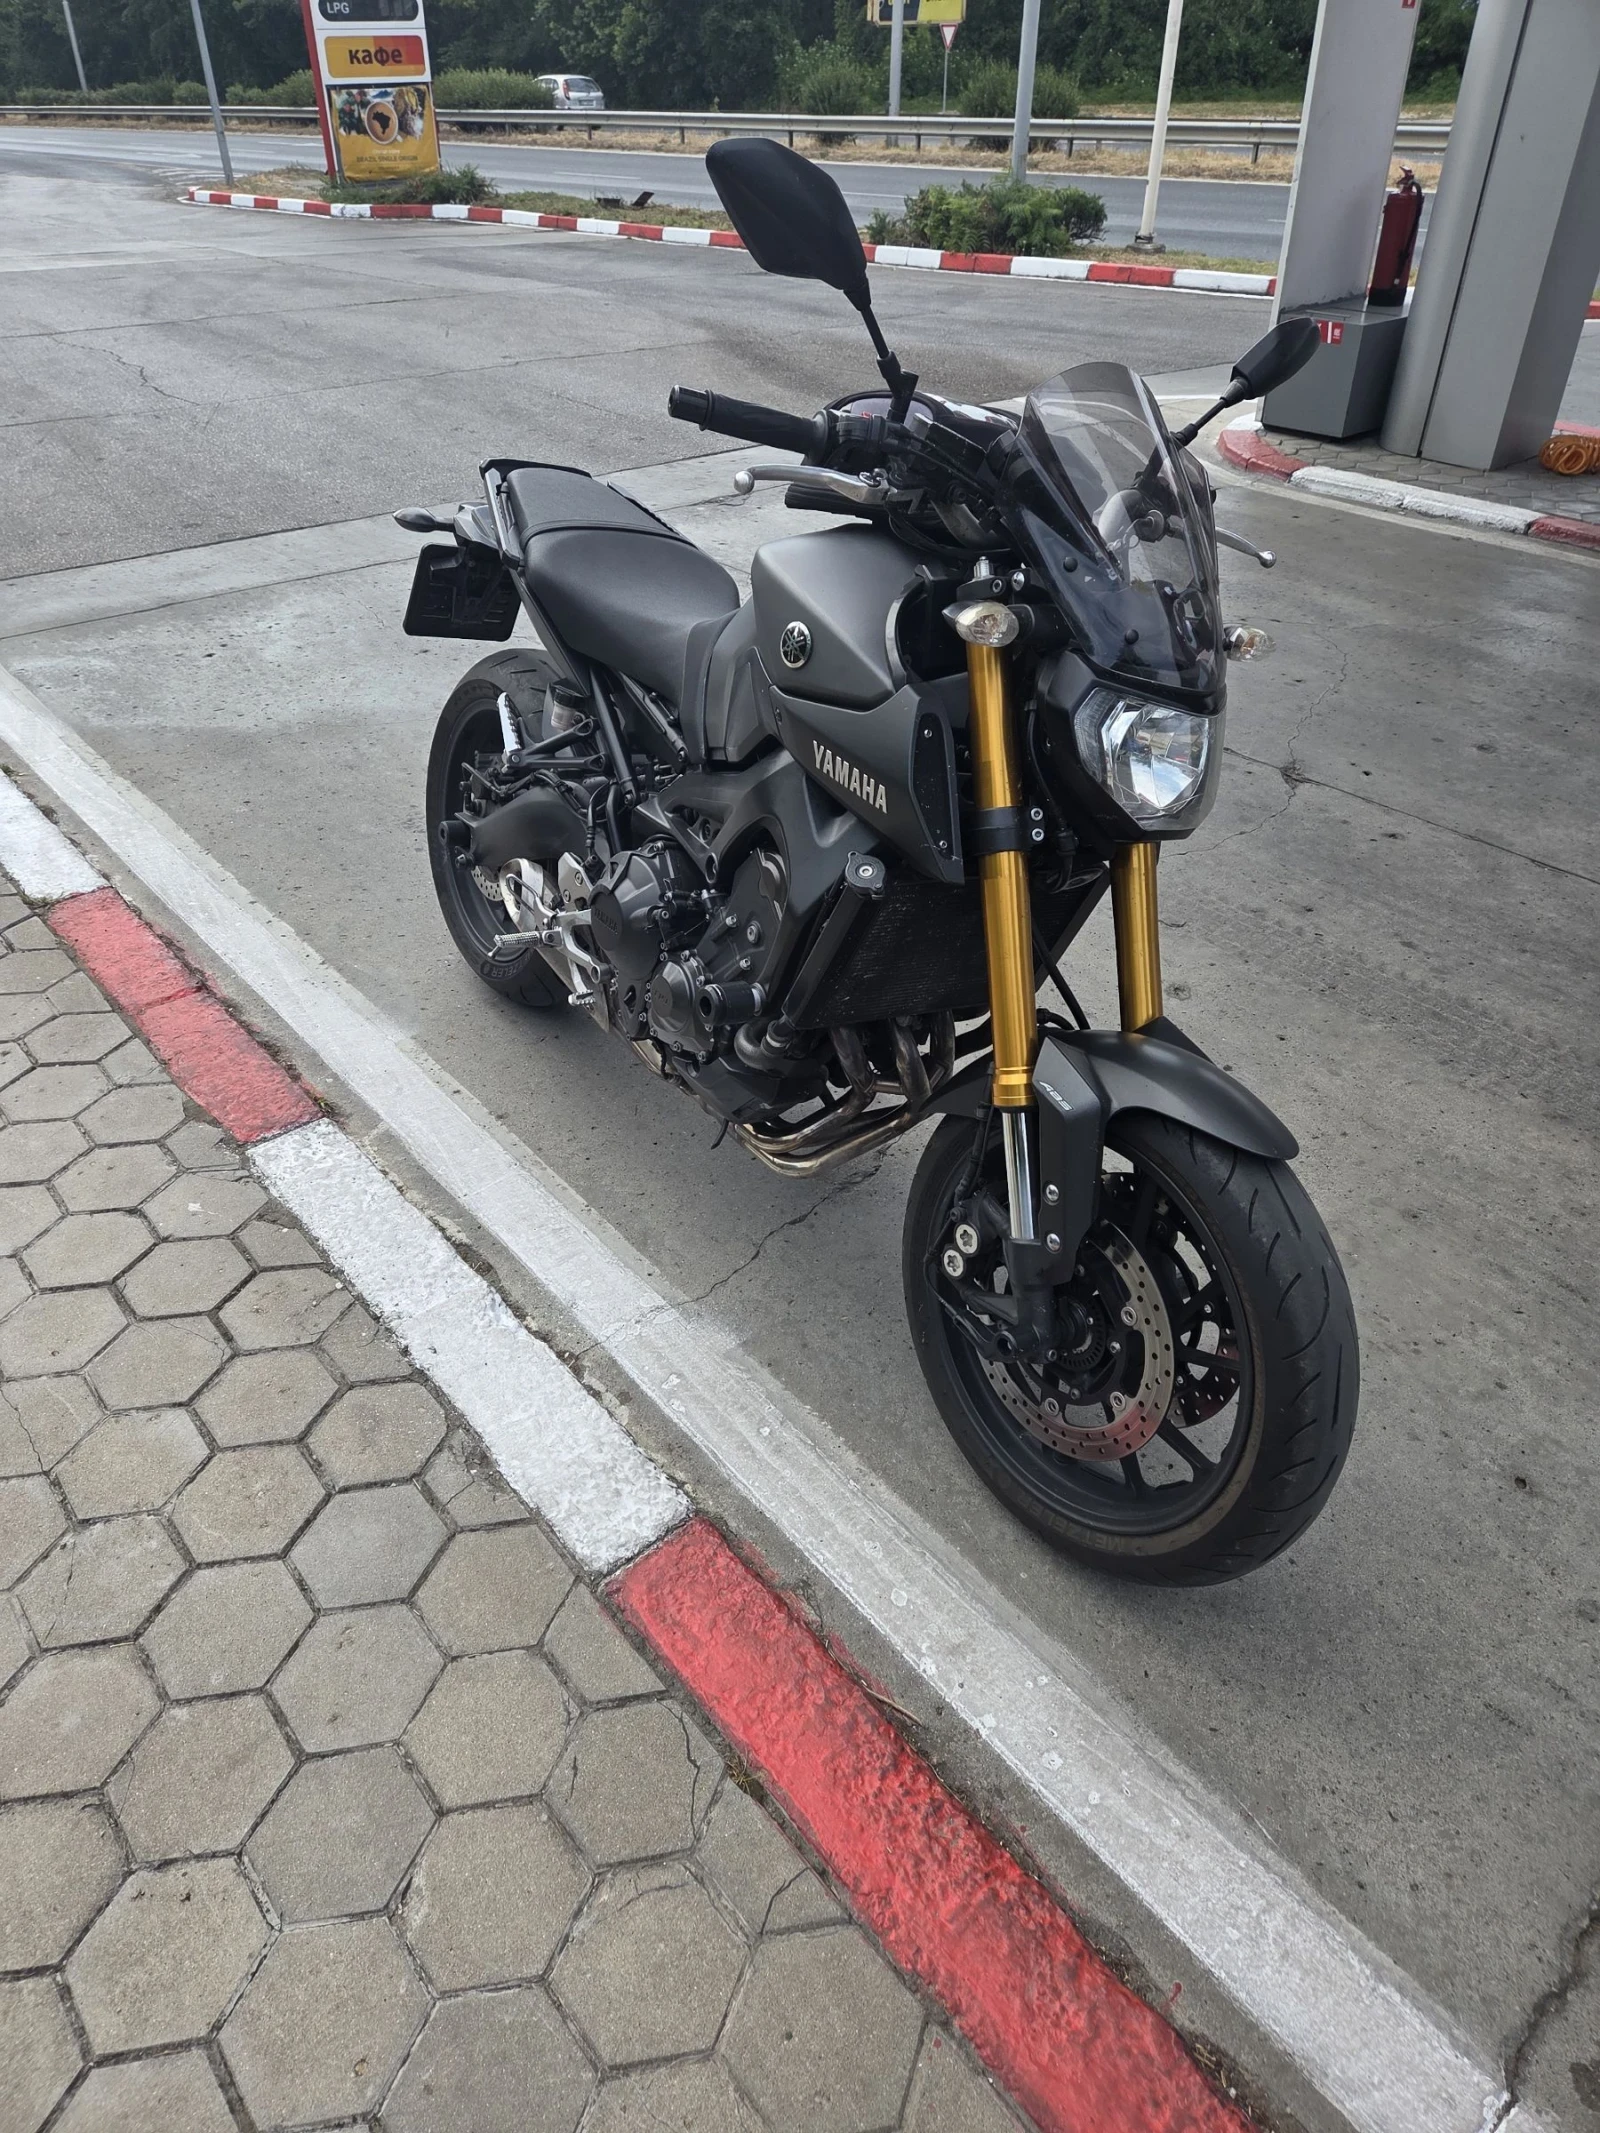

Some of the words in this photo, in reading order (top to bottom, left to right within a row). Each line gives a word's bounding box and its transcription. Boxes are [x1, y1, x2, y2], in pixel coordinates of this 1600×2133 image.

[326, 2, 350, 13] LPG
[348, 46, 403, 66] кафе
[813, 740, 888, 814] YAMAHA
[1039, 1081, 1073, 1111] ABS
